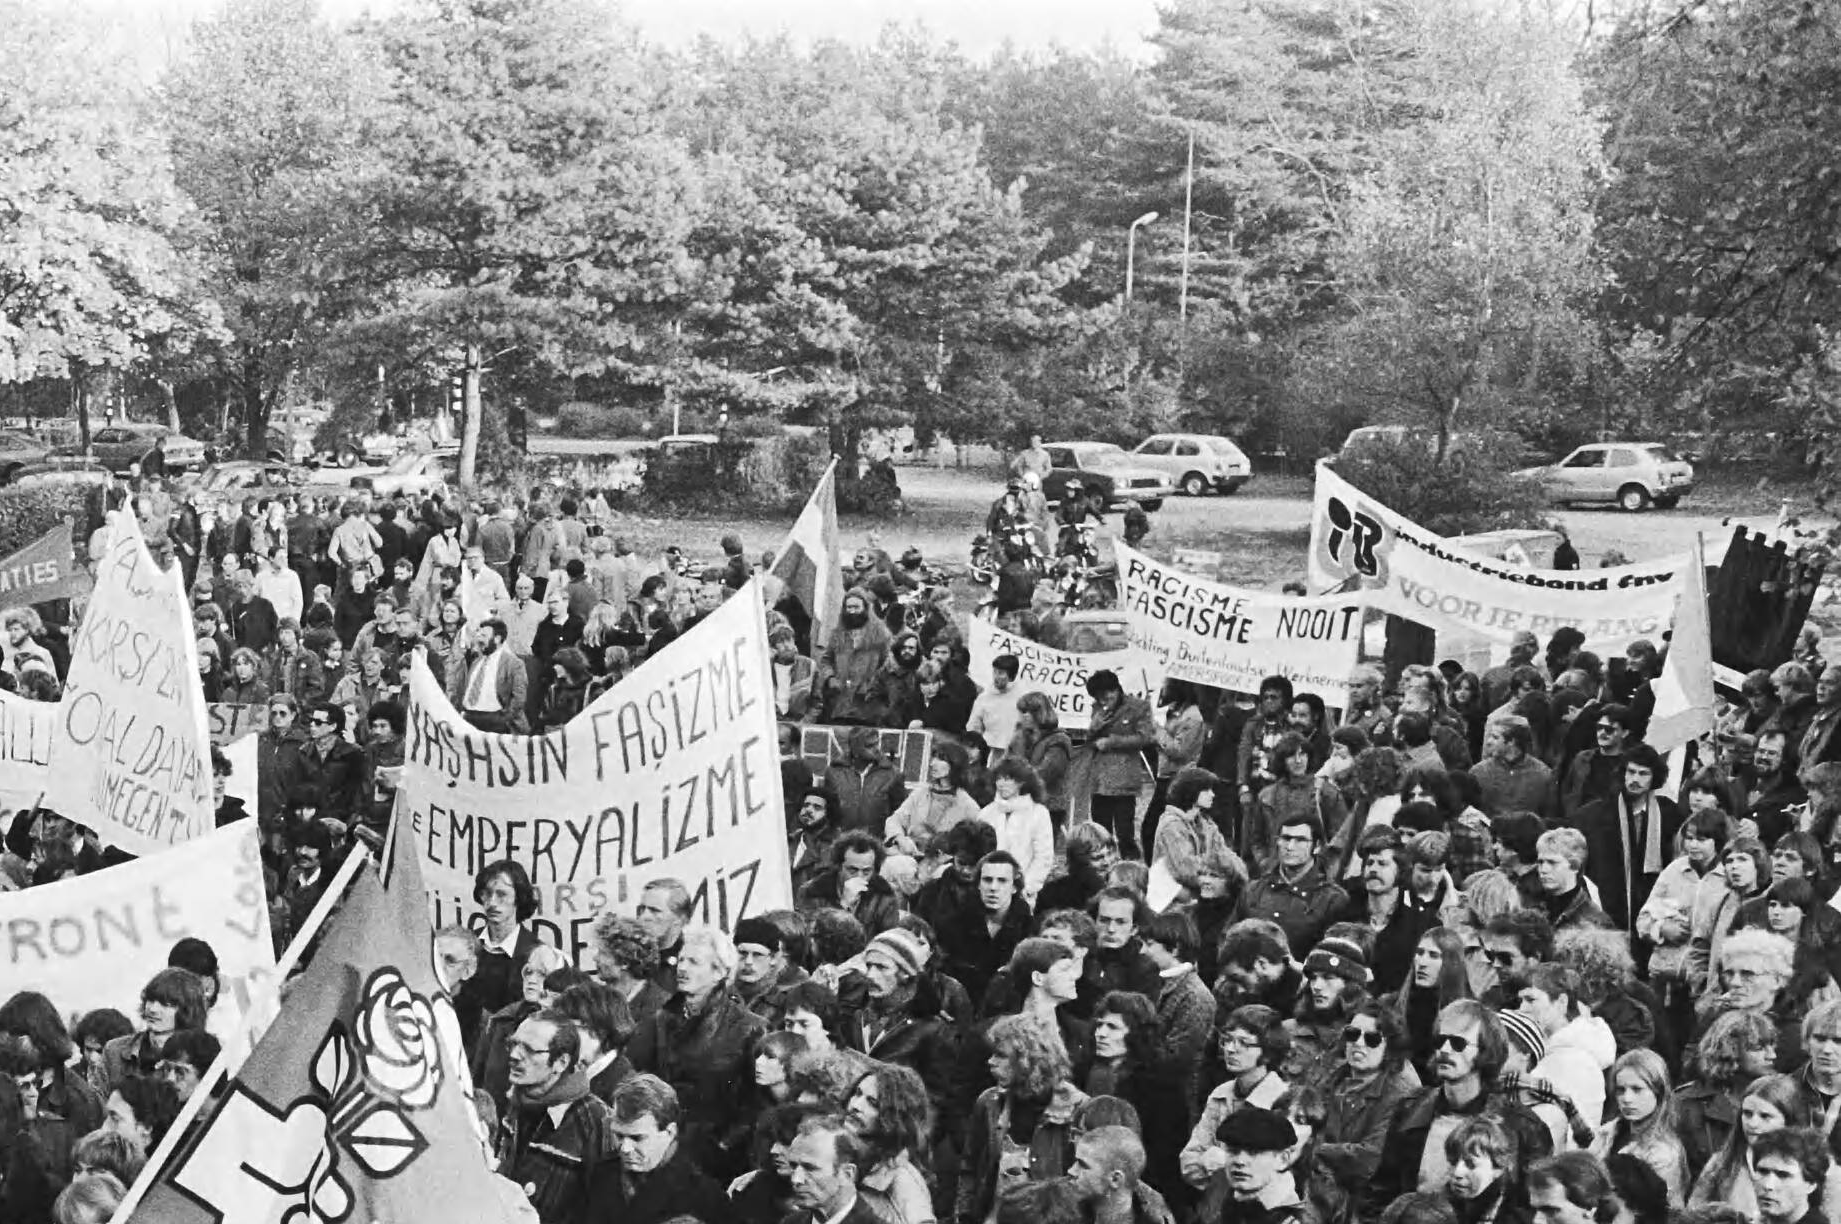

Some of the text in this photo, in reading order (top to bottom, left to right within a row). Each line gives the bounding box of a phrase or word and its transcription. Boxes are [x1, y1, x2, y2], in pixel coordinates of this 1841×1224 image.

[1127, 558, 1251, 616] RACISME
[1397, 575, 1483, 624] VOOR
[1484, 606, 1523, 631] JE
[1618, 571, 1675, 589] fnv
[1126, 586, 1360, 644] FASCISME NOOIT
[990, 633, 1088, 668] FASCISME
